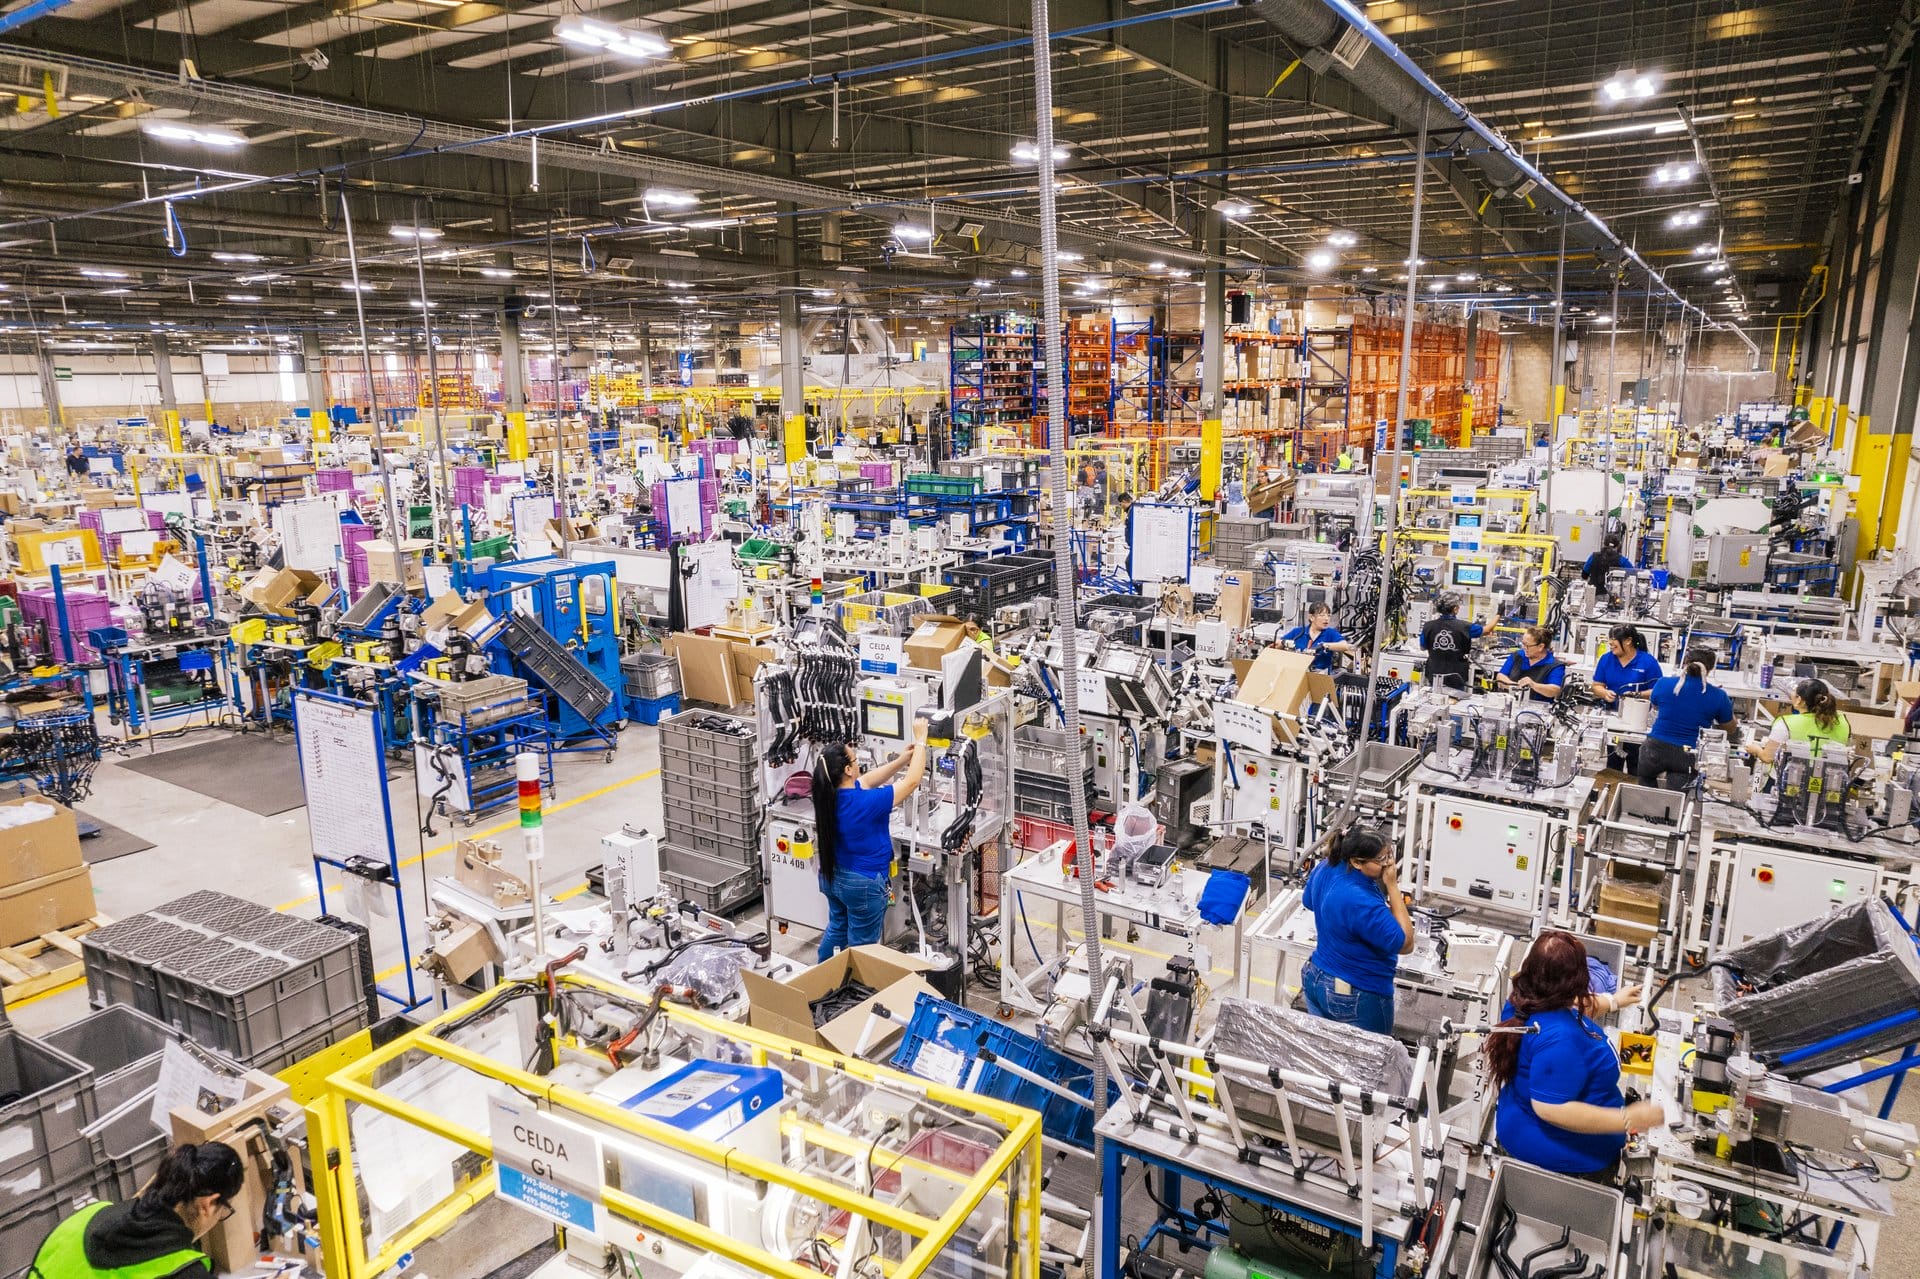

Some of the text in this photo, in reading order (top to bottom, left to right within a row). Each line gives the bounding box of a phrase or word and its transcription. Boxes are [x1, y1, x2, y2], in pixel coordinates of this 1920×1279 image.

[1111, 368, 1116, 377] 3
[869, 642, 891, 651] CELDA
[874, 652, 885, 660] G2
[771, 853, 805, 870] 23 A 409
[1187, 941, 1194, 953] 2
[513, 1125, 569, 1161] CELDA
[531, 1158, 554, 1180] G1
